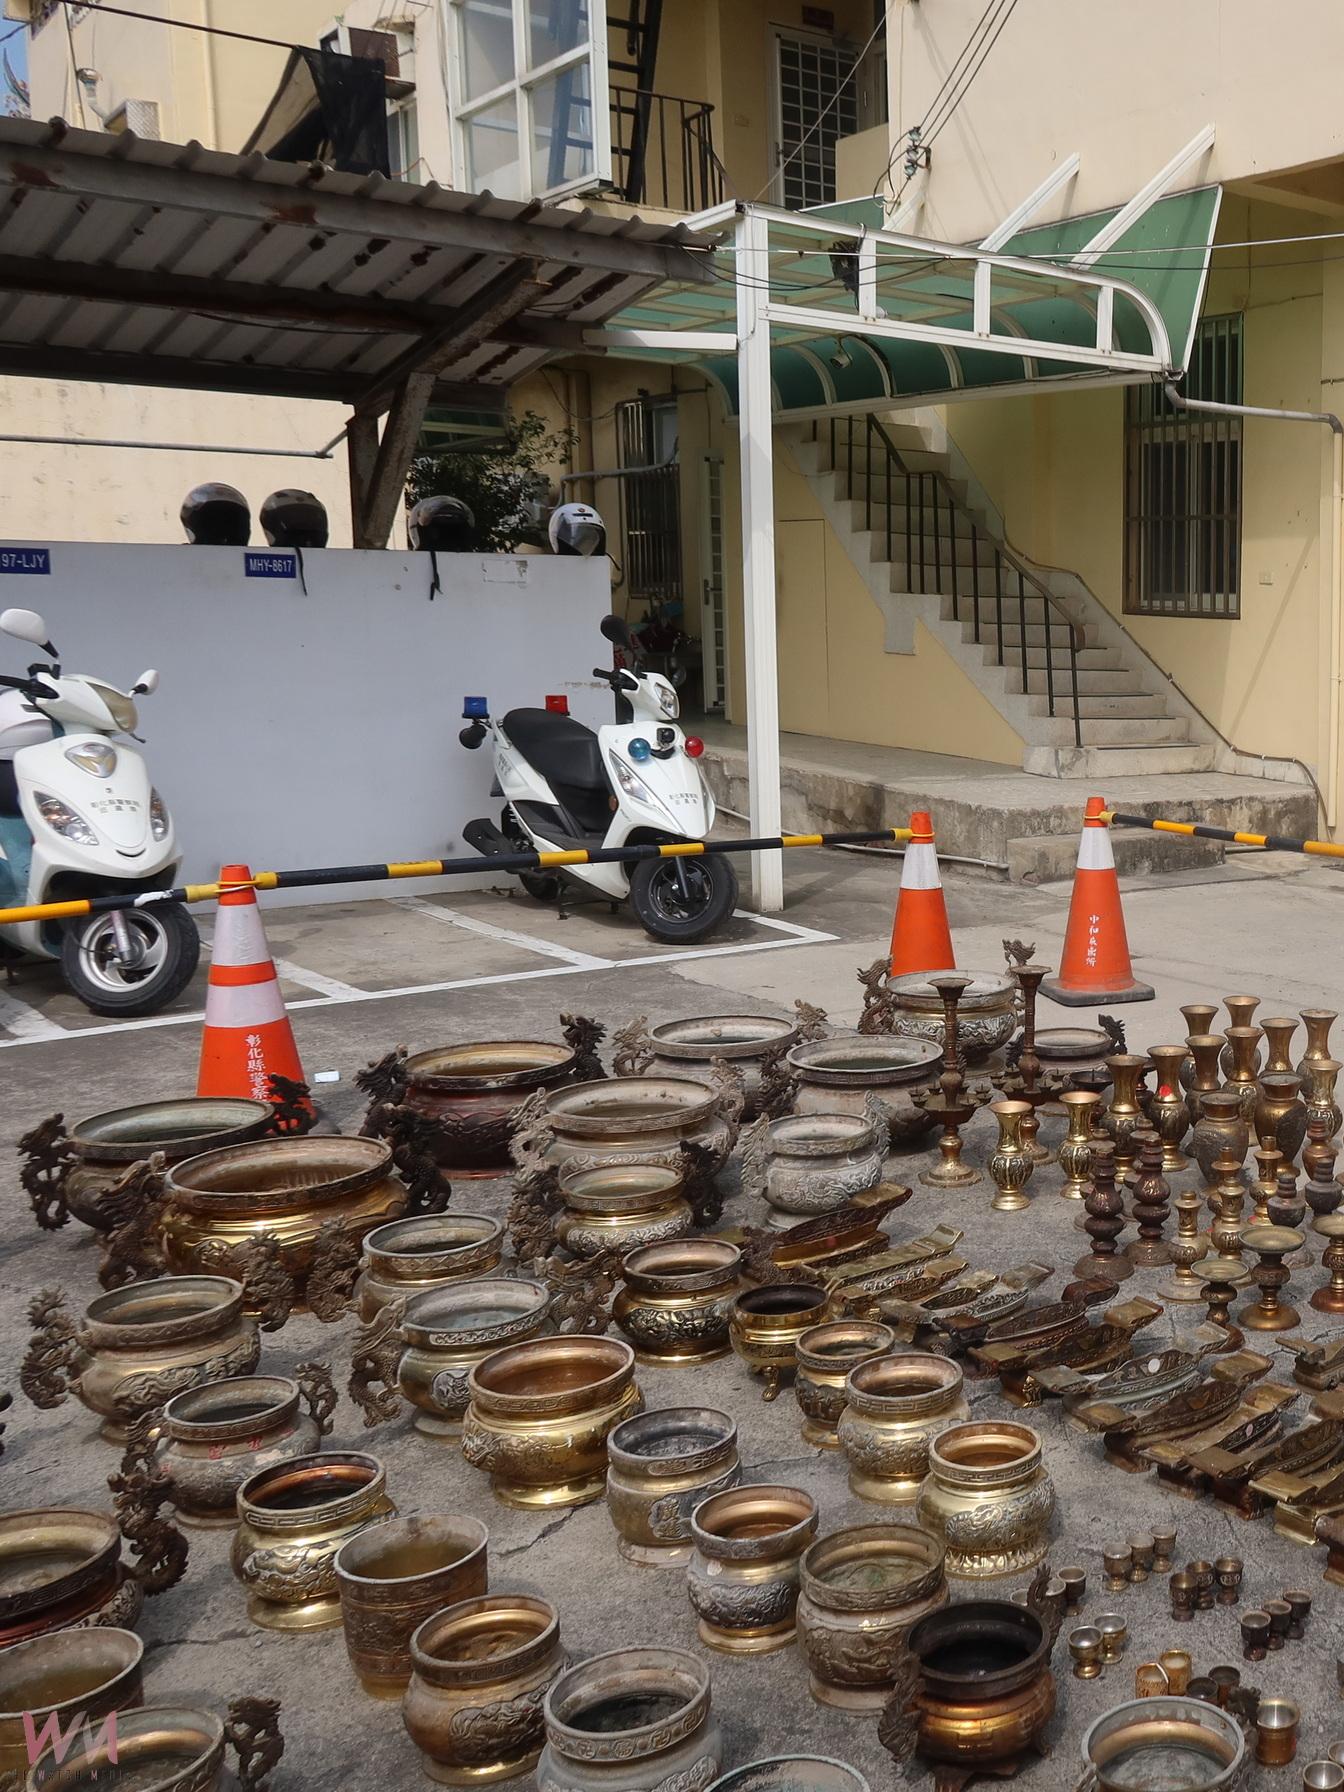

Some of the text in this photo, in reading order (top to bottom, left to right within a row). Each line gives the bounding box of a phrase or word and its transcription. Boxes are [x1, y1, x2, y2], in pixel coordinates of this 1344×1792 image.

[0, 553, 46, 568] 97-LJY
[249, 558, 293, 573] MHY-8617
[245, 1034, 270, 1101] 彰化縣警察
